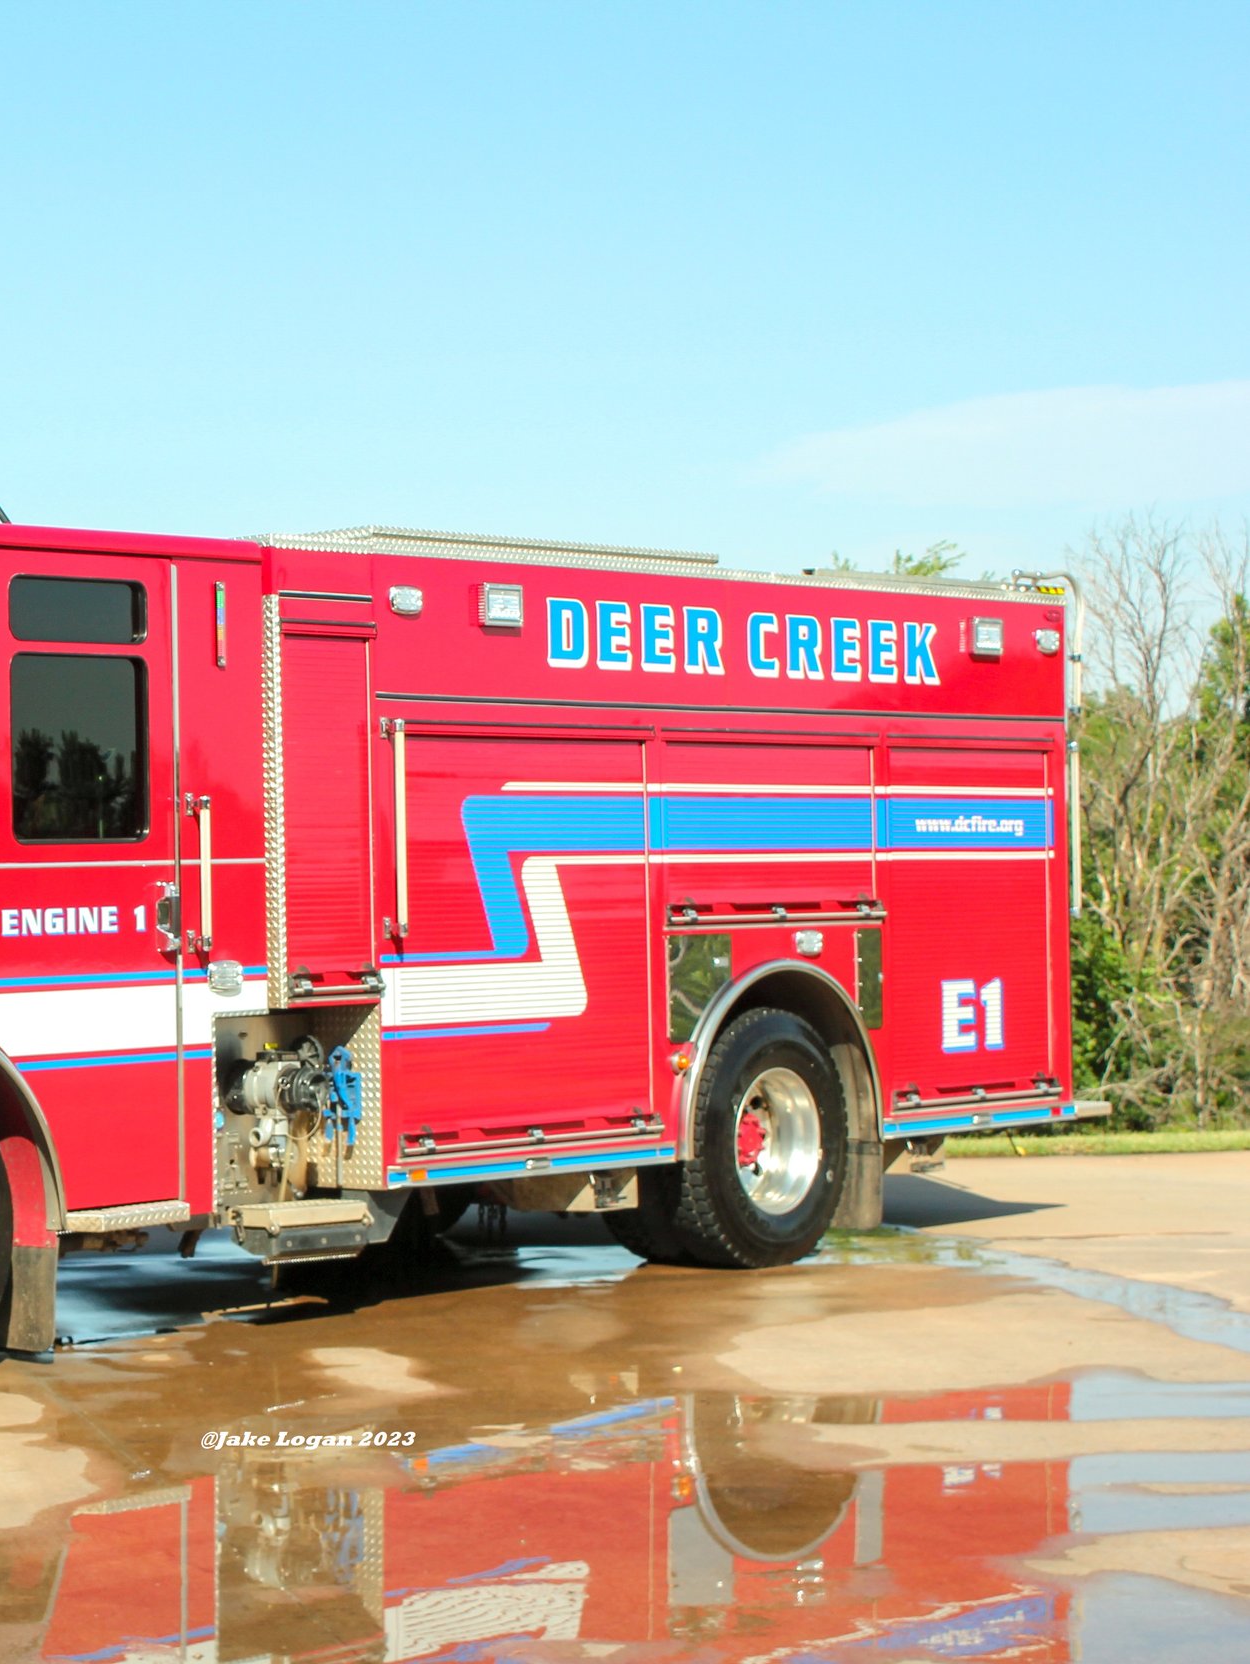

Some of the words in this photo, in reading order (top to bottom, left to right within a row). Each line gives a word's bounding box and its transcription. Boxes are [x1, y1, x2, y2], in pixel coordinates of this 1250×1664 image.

[546, 597, 725, 675] DEER
[747, 611, 941, 686] CREEK
[915, 815, 1024, 837] www.dcfire.org
[1, 906, 119, 937] ENGINE
[133, 905, 146, 933] 1
[940, 976, 1005, 1054] E1
